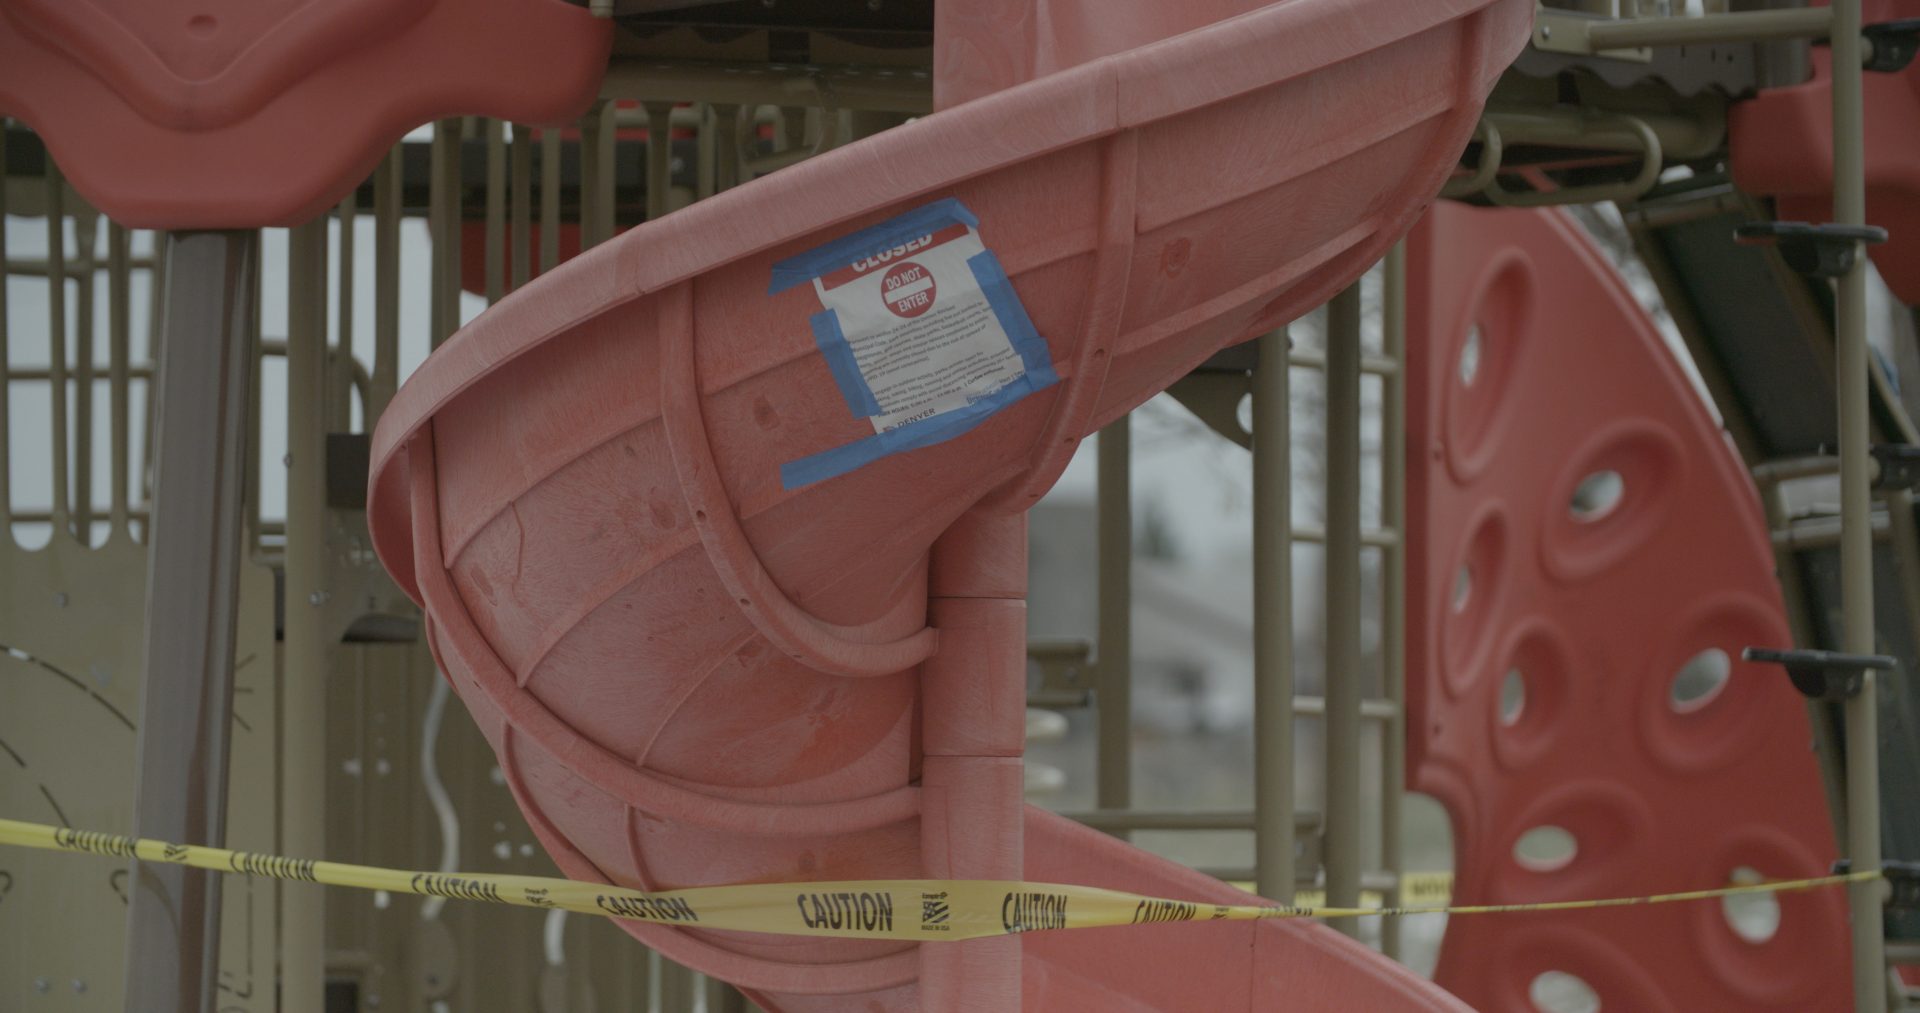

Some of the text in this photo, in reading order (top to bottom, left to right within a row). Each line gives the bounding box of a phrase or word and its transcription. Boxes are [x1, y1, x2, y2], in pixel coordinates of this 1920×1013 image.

[886, 267, 921, 290] DO NOT
[898, 292, 928, 312] ENTER
[897, 408, 936, 428] DENVER
[596, 894, 699, 922] CAUTION
[797, 892, 894, 932] CAUTION
[1002, 892, 1069, 933] CAUTION
[1131, 900, 1197, 924] CAUTION
